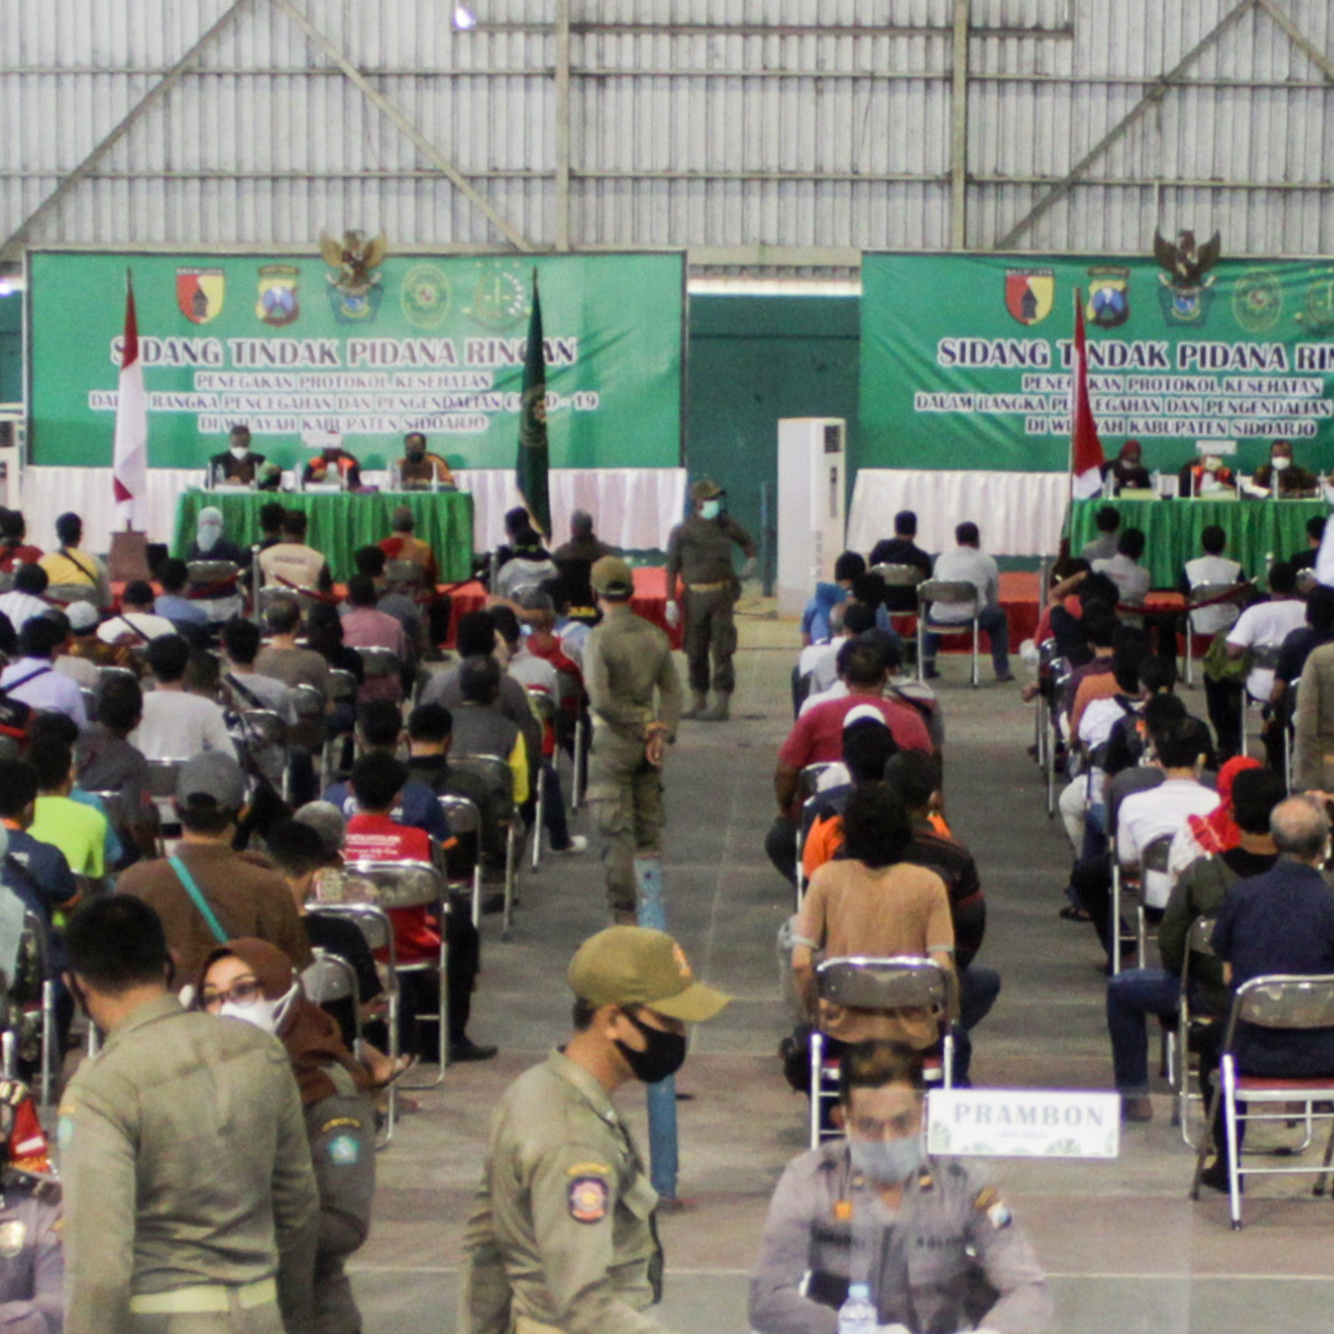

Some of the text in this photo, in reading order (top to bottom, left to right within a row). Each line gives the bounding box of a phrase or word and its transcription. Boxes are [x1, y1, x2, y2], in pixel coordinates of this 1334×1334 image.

[113, 339, 220, 364] SDANG
[231, 340, 338, 365] TINDAK
[349, 340, 456, 365] PIDANA
[940, 340, 1049, 366] SIDANG
[1058, 342, 1167, 367] TNDAK
[1178, 344, 1286, 370] PIDANA
[197, 376, 490, 390] PENEGAKAN PROTOKOL KESEHATAN
[1129, 378, 1218, 392] PROTOKOL
[1225, 379, 1320, 394] KESEHATAN
[152, 394, 217, 408] RANGKA
[223, 395, 331, 409] PENCEGAHAN
[338, 395, 371, 409] DAN
[377, 395, 501, 409] PENGENDALIAN
[917, 395, 972, 409] DALAM
[978, 396, 1046, 410] RANGKA
[1168, 399, 1201, 414] DAN
[1206, 400, 1331, 416] PENGENDALIAN
[201, 417, 218, 430] DI
[404, 417, 487, 431] SIDOARJO
[1027, 419, 1044, 432] DI
[1130, 420, 1229, 435] KABUPATEN
[1230, 421, 1315, 436] SIDOARJO
[954, 1103, 1104, 1127] PRAMBON
